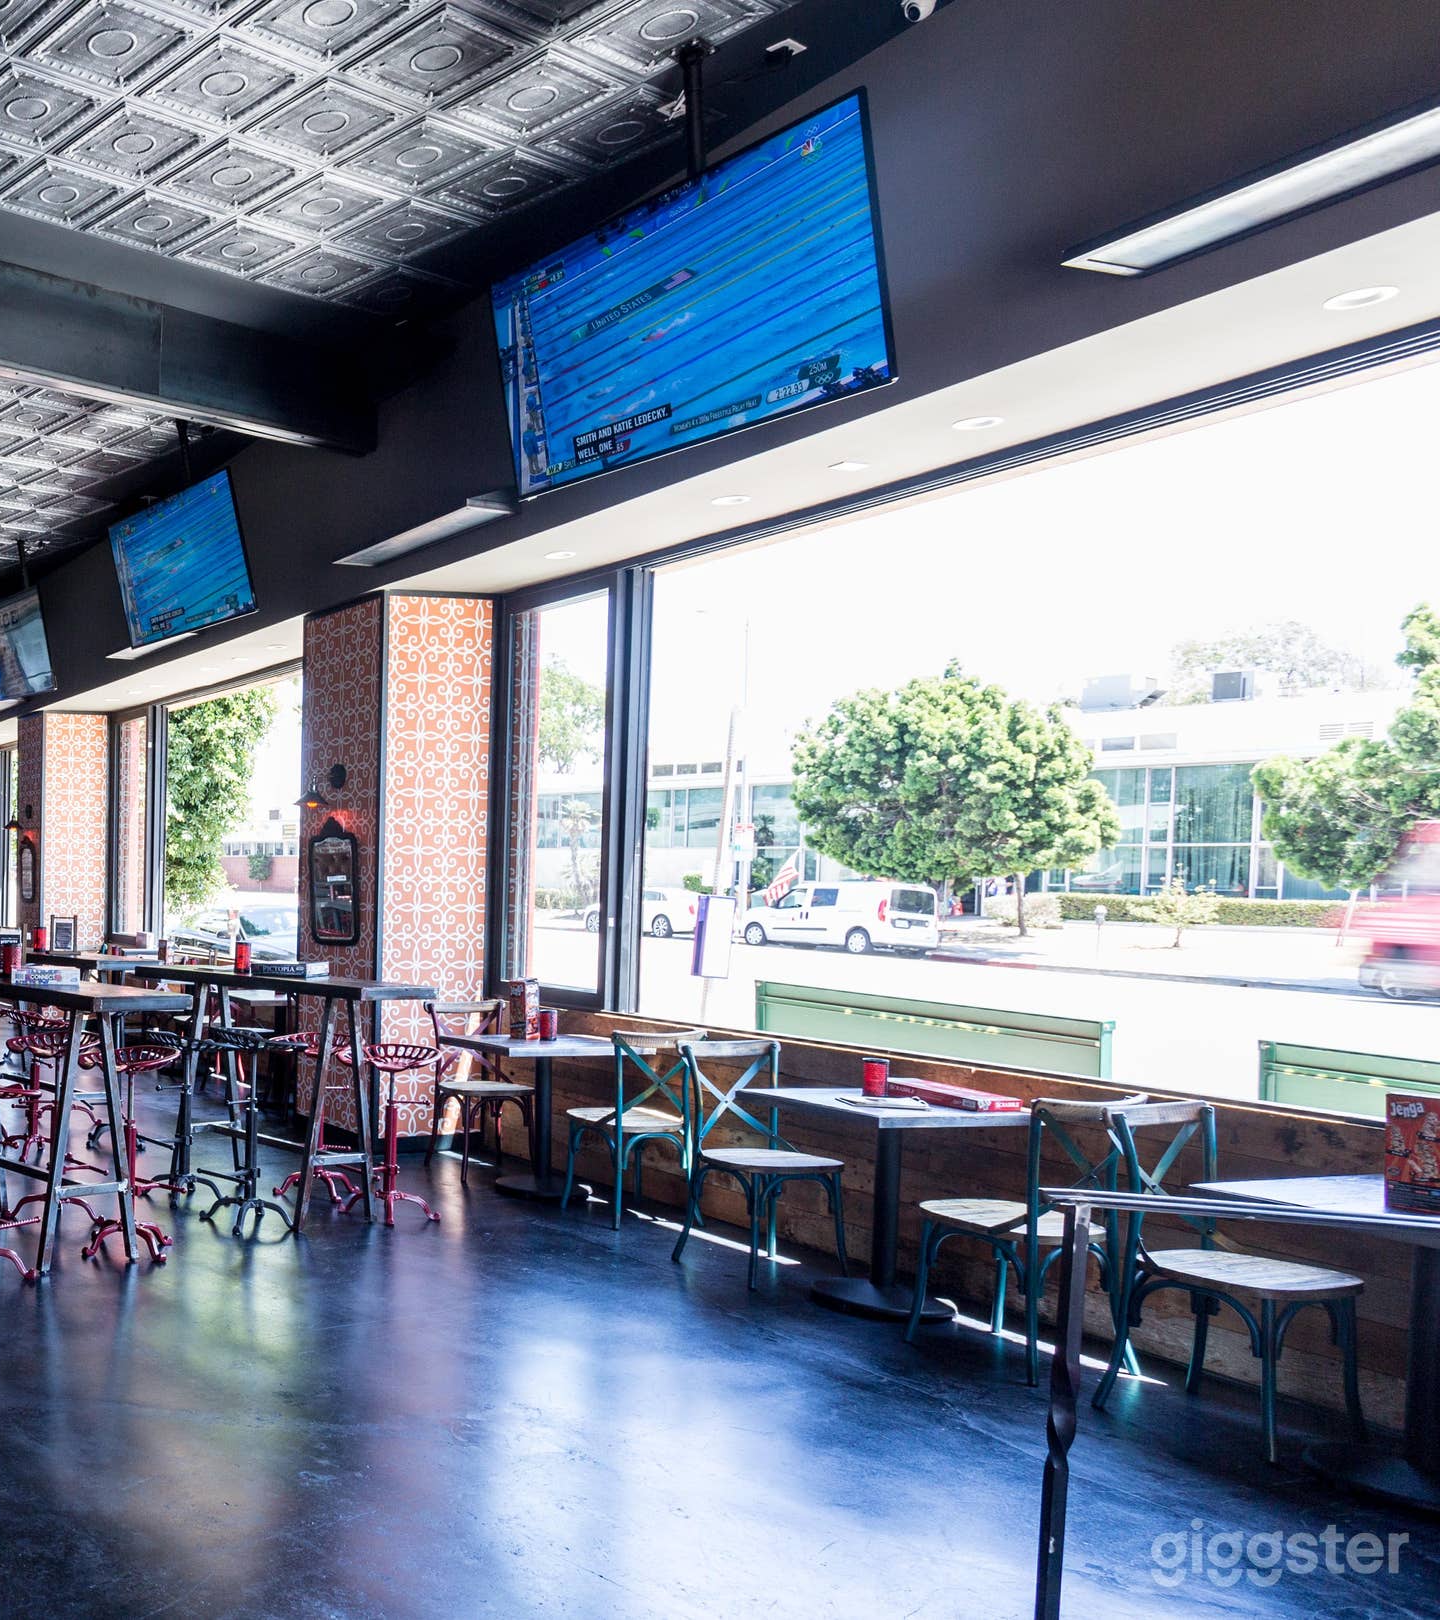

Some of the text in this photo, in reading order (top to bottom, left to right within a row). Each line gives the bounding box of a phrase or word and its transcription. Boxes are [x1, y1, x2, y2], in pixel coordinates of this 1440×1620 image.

[591, 310, 621, 330] UNITED
[620, 293, 653, 314] STATES
[575, 407, 669, 448] SMITH AND KATIE LEDECKY.
[599, 440, 614, 452] ONE
[1389, 1101, 1425, 1118] Jenga
